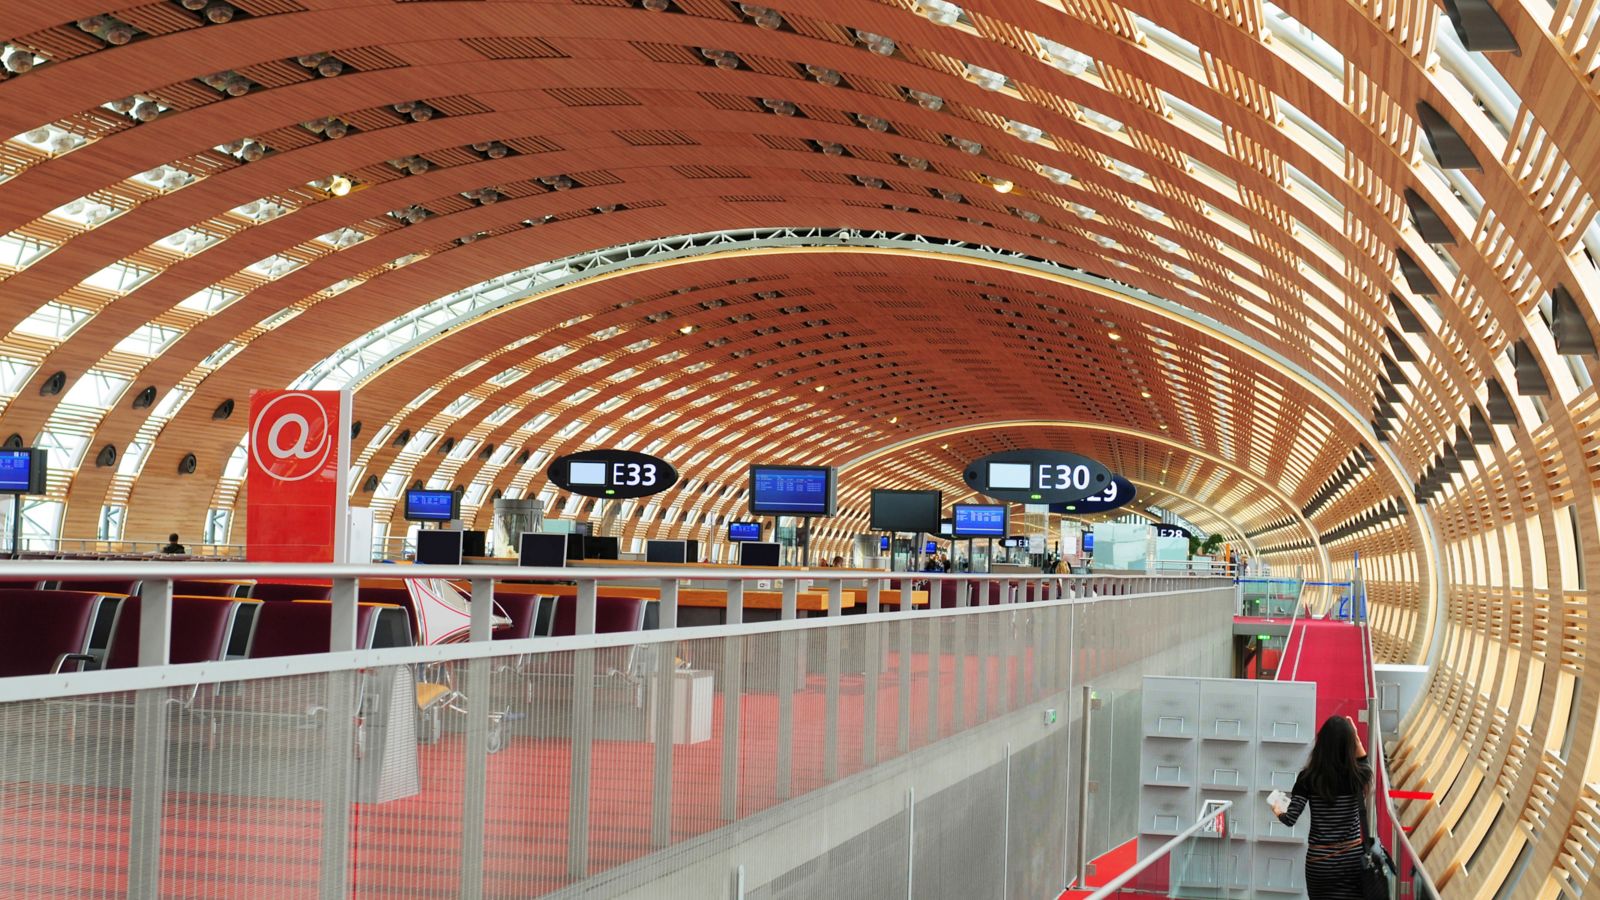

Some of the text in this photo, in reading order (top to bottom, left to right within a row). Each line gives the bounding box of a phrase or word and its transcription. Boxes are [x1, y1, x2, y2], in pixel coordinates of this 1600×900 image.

[252, 393, 331, 481] @
[613, 463, 656, 486] E33
[1039, 465, 1090, 490] E30
